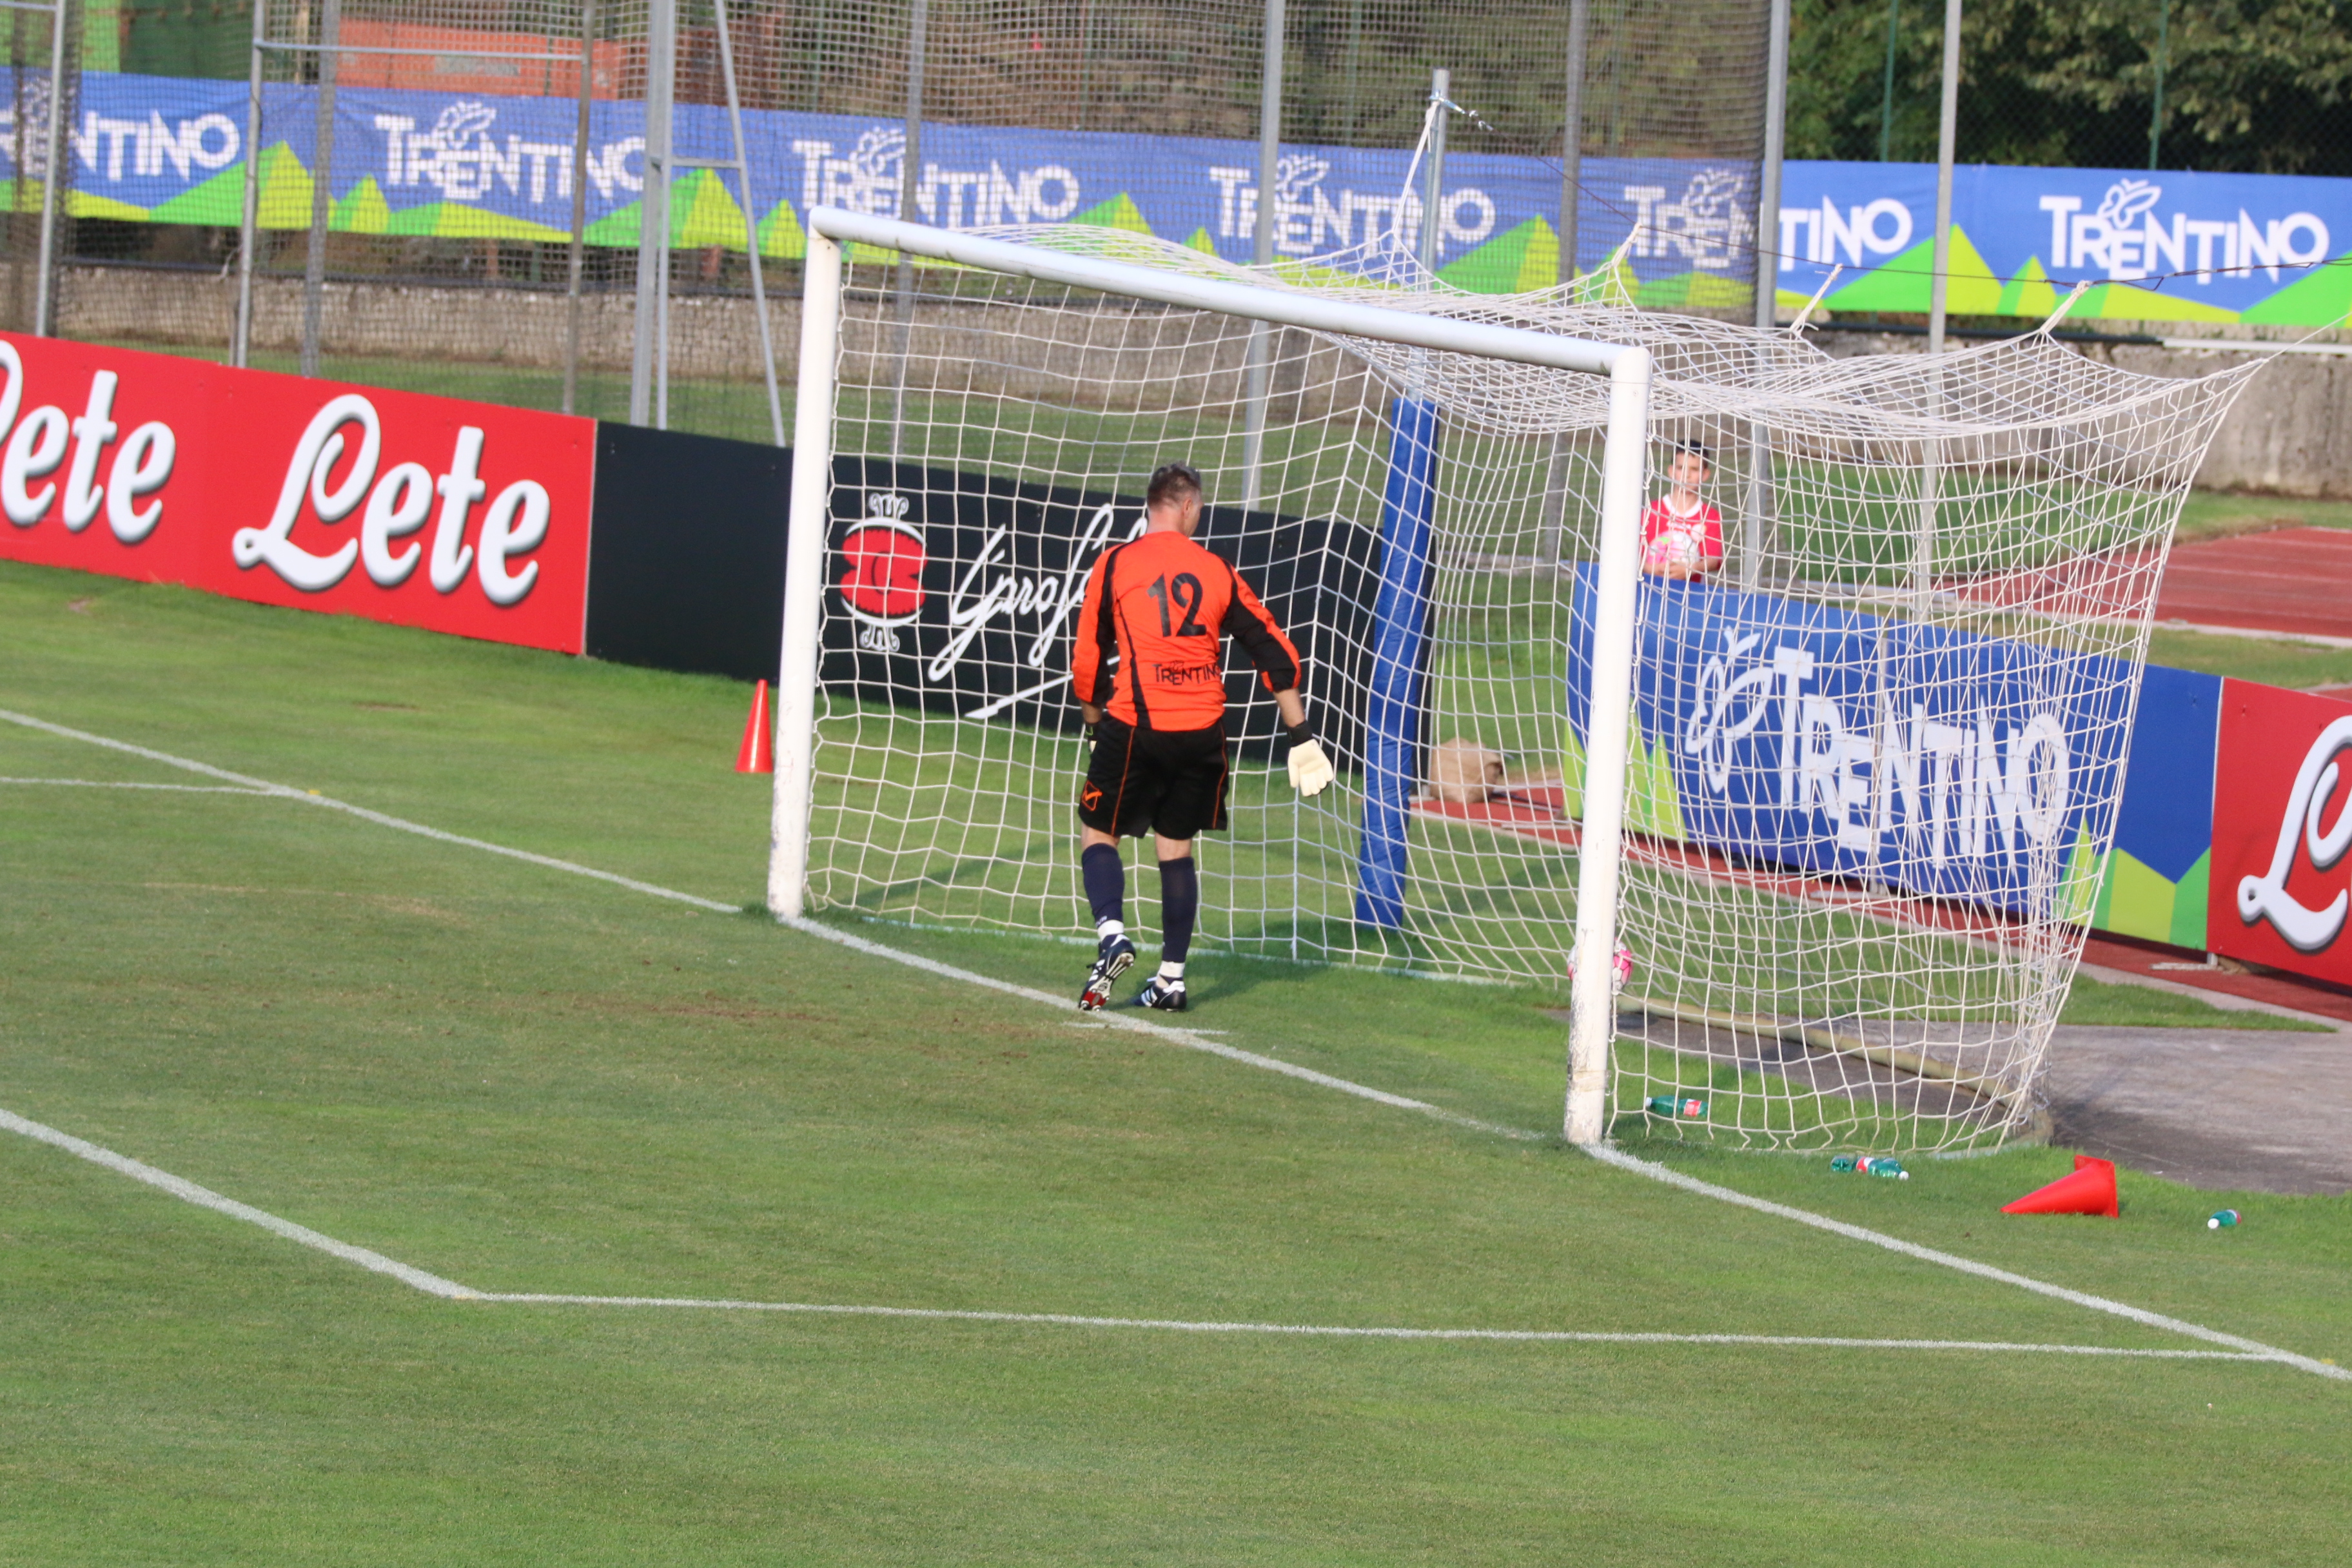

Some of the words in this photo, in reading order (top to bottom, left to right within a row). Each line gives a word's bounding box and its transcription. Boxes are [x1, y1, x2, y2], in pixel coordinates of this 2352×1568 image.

[2039, 195, 2330, 285] TRENTINO
[232, 393, 552, 606] Lete
[1146, 572, 1206, 638] 12
[1774, 645, 2070, 876] TRENTINO
